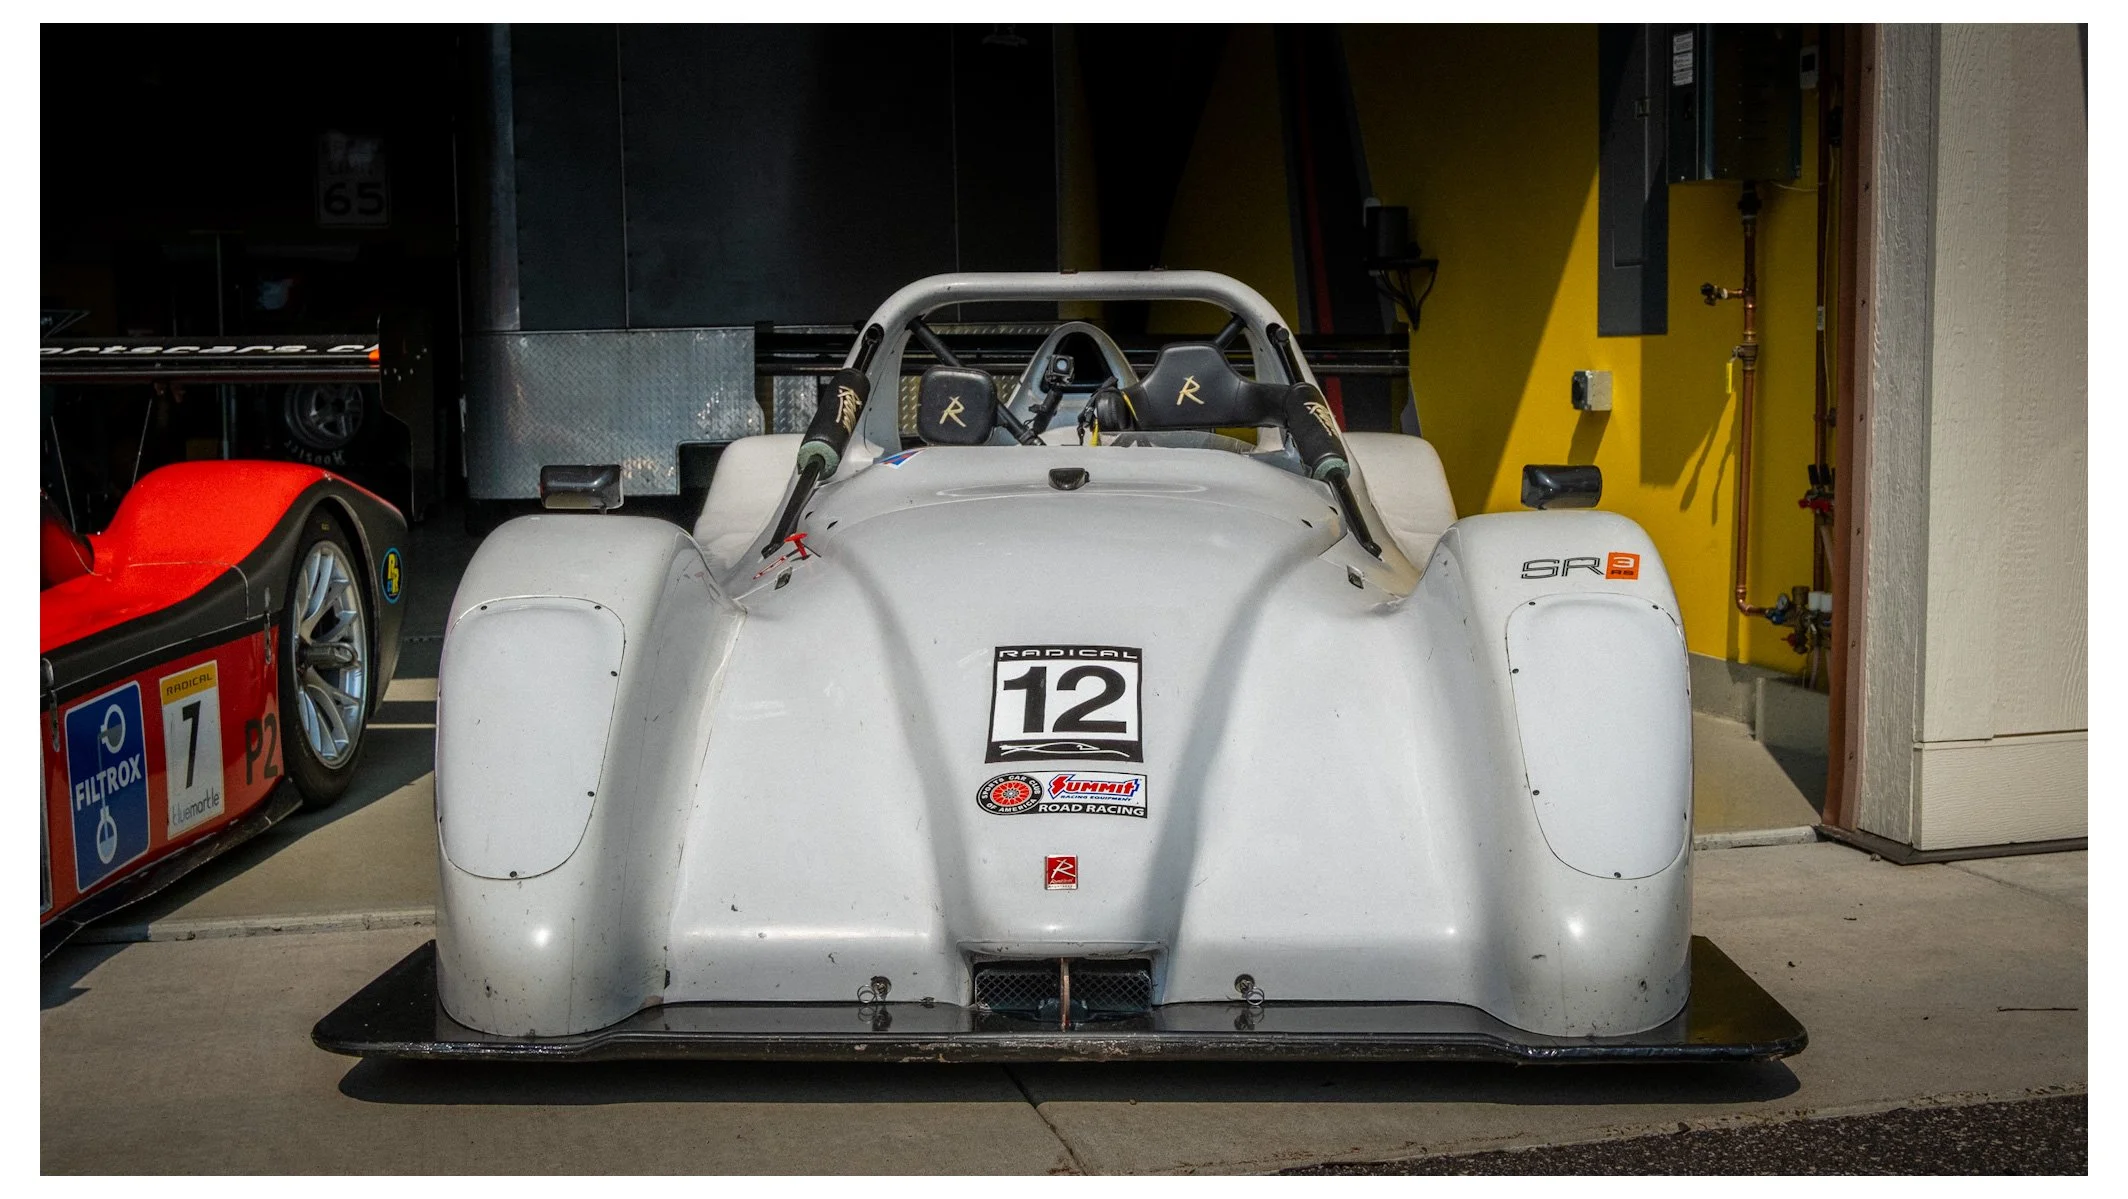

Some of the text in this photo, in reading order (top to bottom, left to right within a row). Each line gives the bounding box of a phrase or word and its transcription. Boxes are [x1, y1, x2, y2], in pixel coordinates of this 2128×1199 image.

[324, 182, 384, 215] 65
[1176, 375, 1205, 405] R
[939, 396, 967, 428] R
[1000, 649, 1138, 659] RADICAL
[166, 673, 213, 696] RADICAL
[1003, 665, 1127, 734] 12
[182, 701, 201, 789] 7
[244, 712, 278, 786] P2
[75, 753, 142, 812] FILTROX
[1008, 774, 1028, 782] CAR
[998, 798, 1038, 813] AMERICA
[1038, 804, 1145, 816] ROAD RACING
